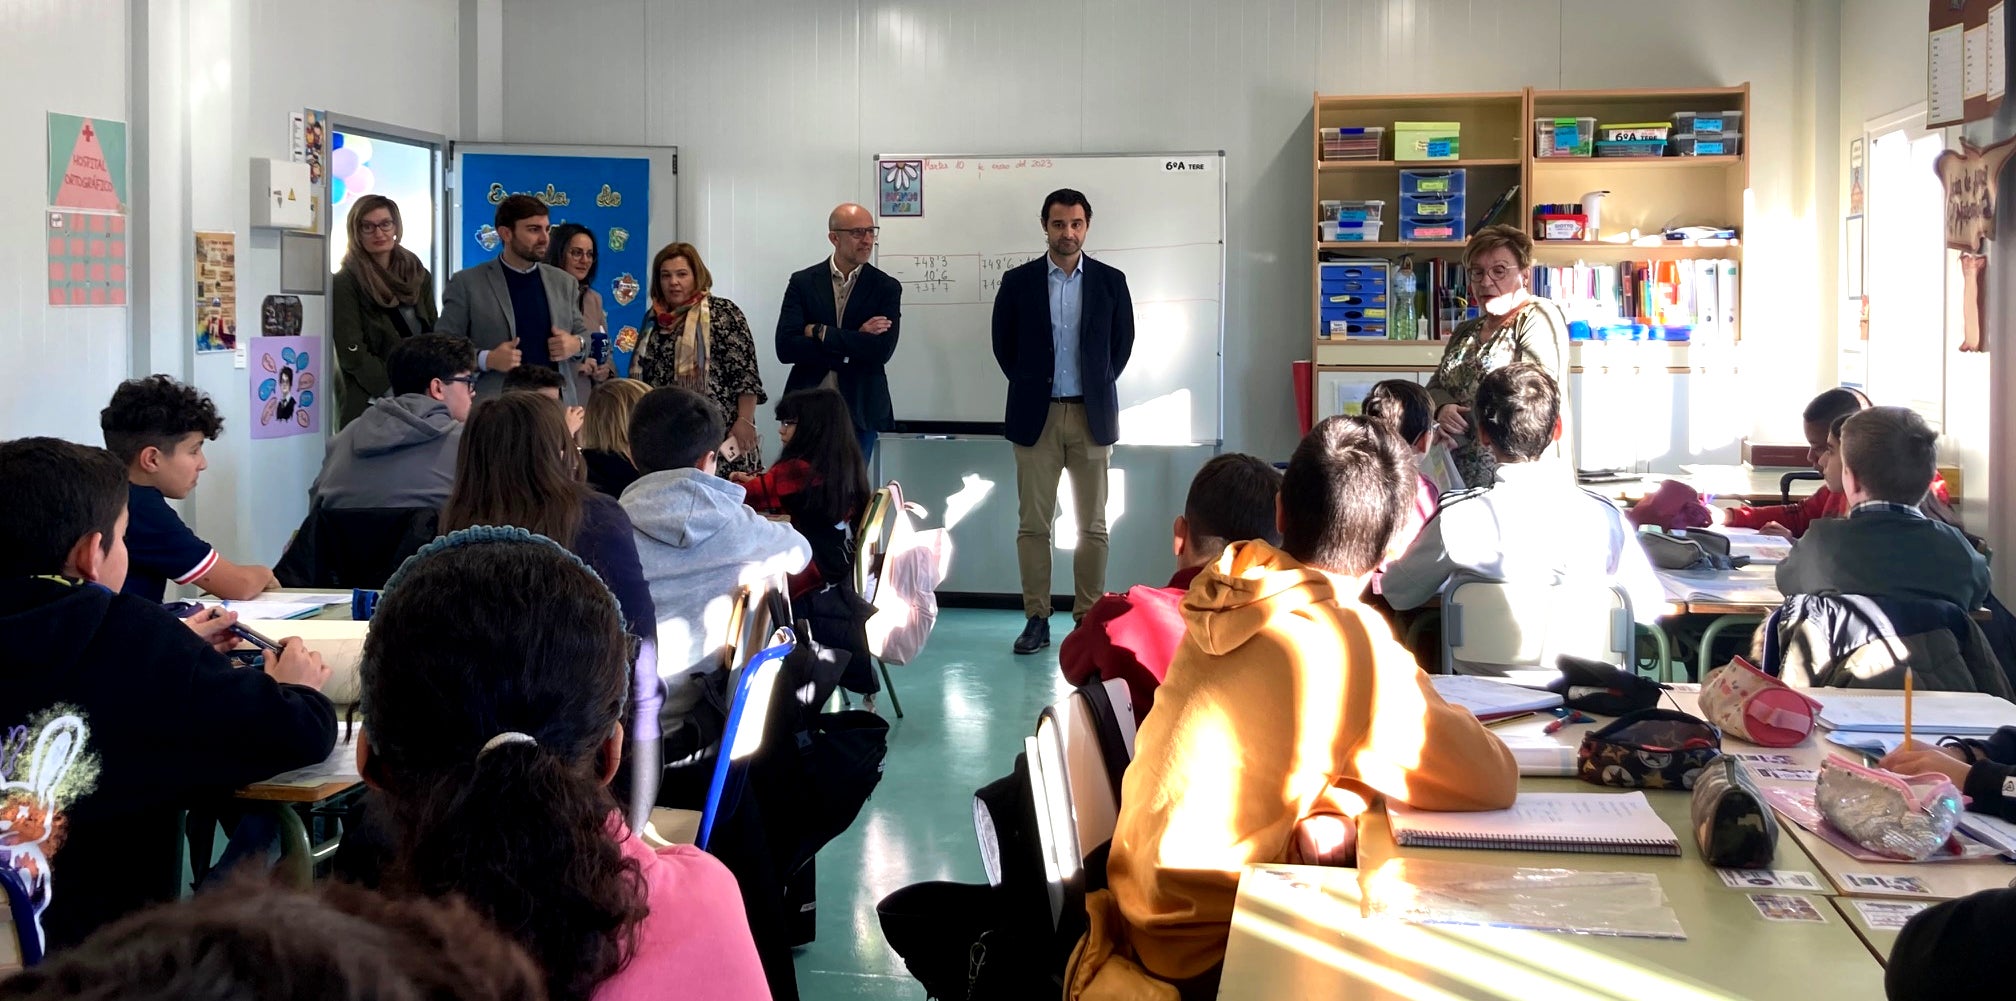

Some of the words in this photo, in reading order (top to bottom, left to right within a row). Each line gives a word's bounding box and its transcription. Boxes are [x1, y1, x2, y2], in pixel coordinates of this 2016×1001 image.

[72, 154, 107, 172] HOSPITAL
[924, 158, 949, 170] Martes
[955, 160, 965, 170] 10
[1031, 159, 1053, 169] 2023
[1165, 161, 1185, 170] 6ºA
[64, 174, 114, 192] ORTOGRÁFICO
[913, 255, 948, 269] 748'3
